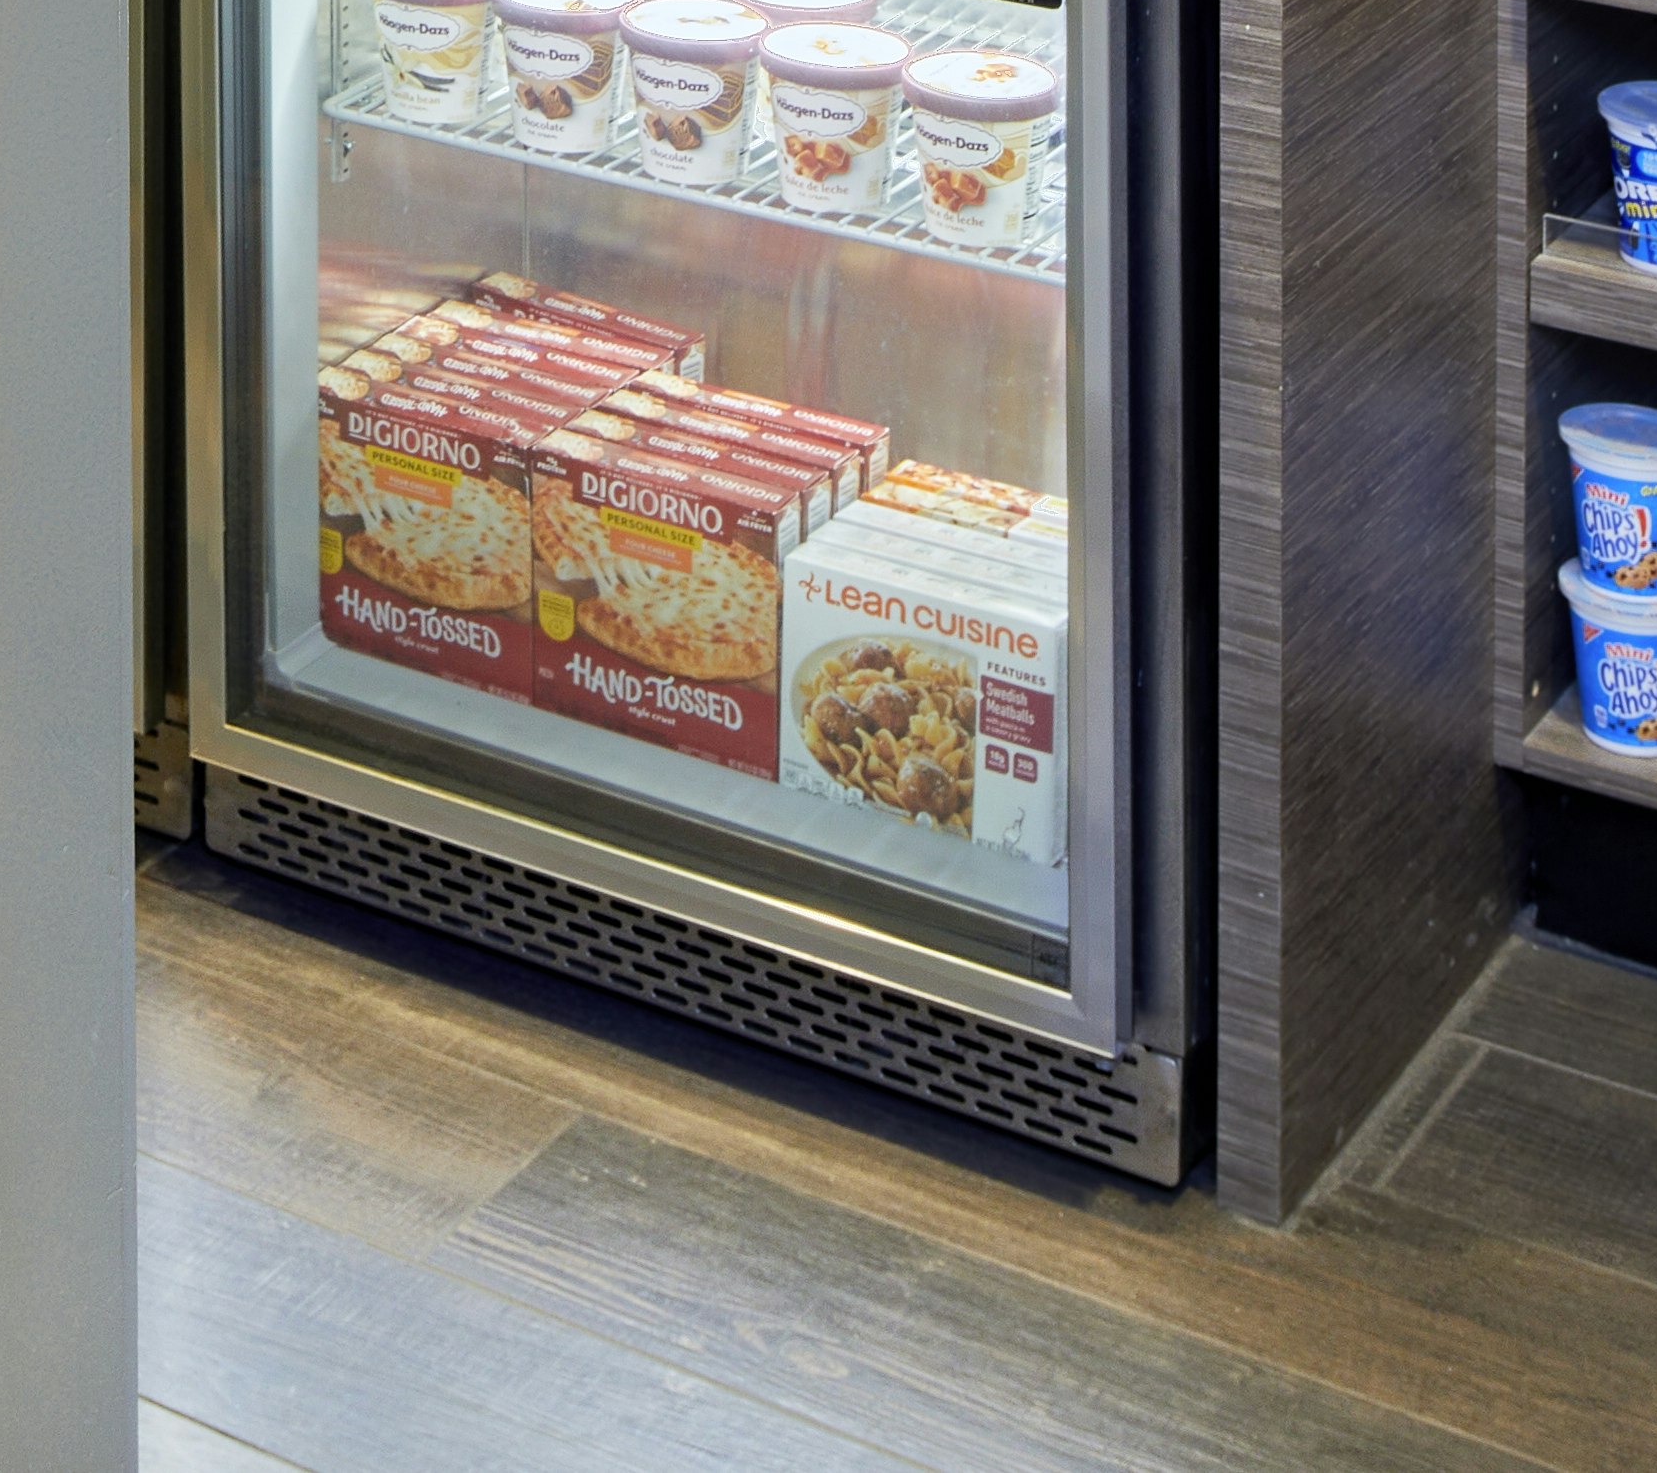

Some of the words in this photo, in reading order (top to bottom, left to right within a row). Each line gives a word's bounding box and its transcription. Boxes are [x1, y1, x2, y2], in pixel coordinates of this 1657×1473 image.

[372, 450, 428, 476] PERSONAL
[431, 467, 455, 482] SIZE
[607, 512, 667, 540] PERSONAL
[670, 529, 696, 546] SIZE
[1583, 501, 1636, 534] Chips
[335, 585, 501, 659] HAND-TOSSED
[986, 661, 1046, 687] FEATURES
[564, 652, 742, 731] HAND-TOSSED
[985, 680, 1028, 706] Swedish
[985, 700, 1035, 726] Meatballs
